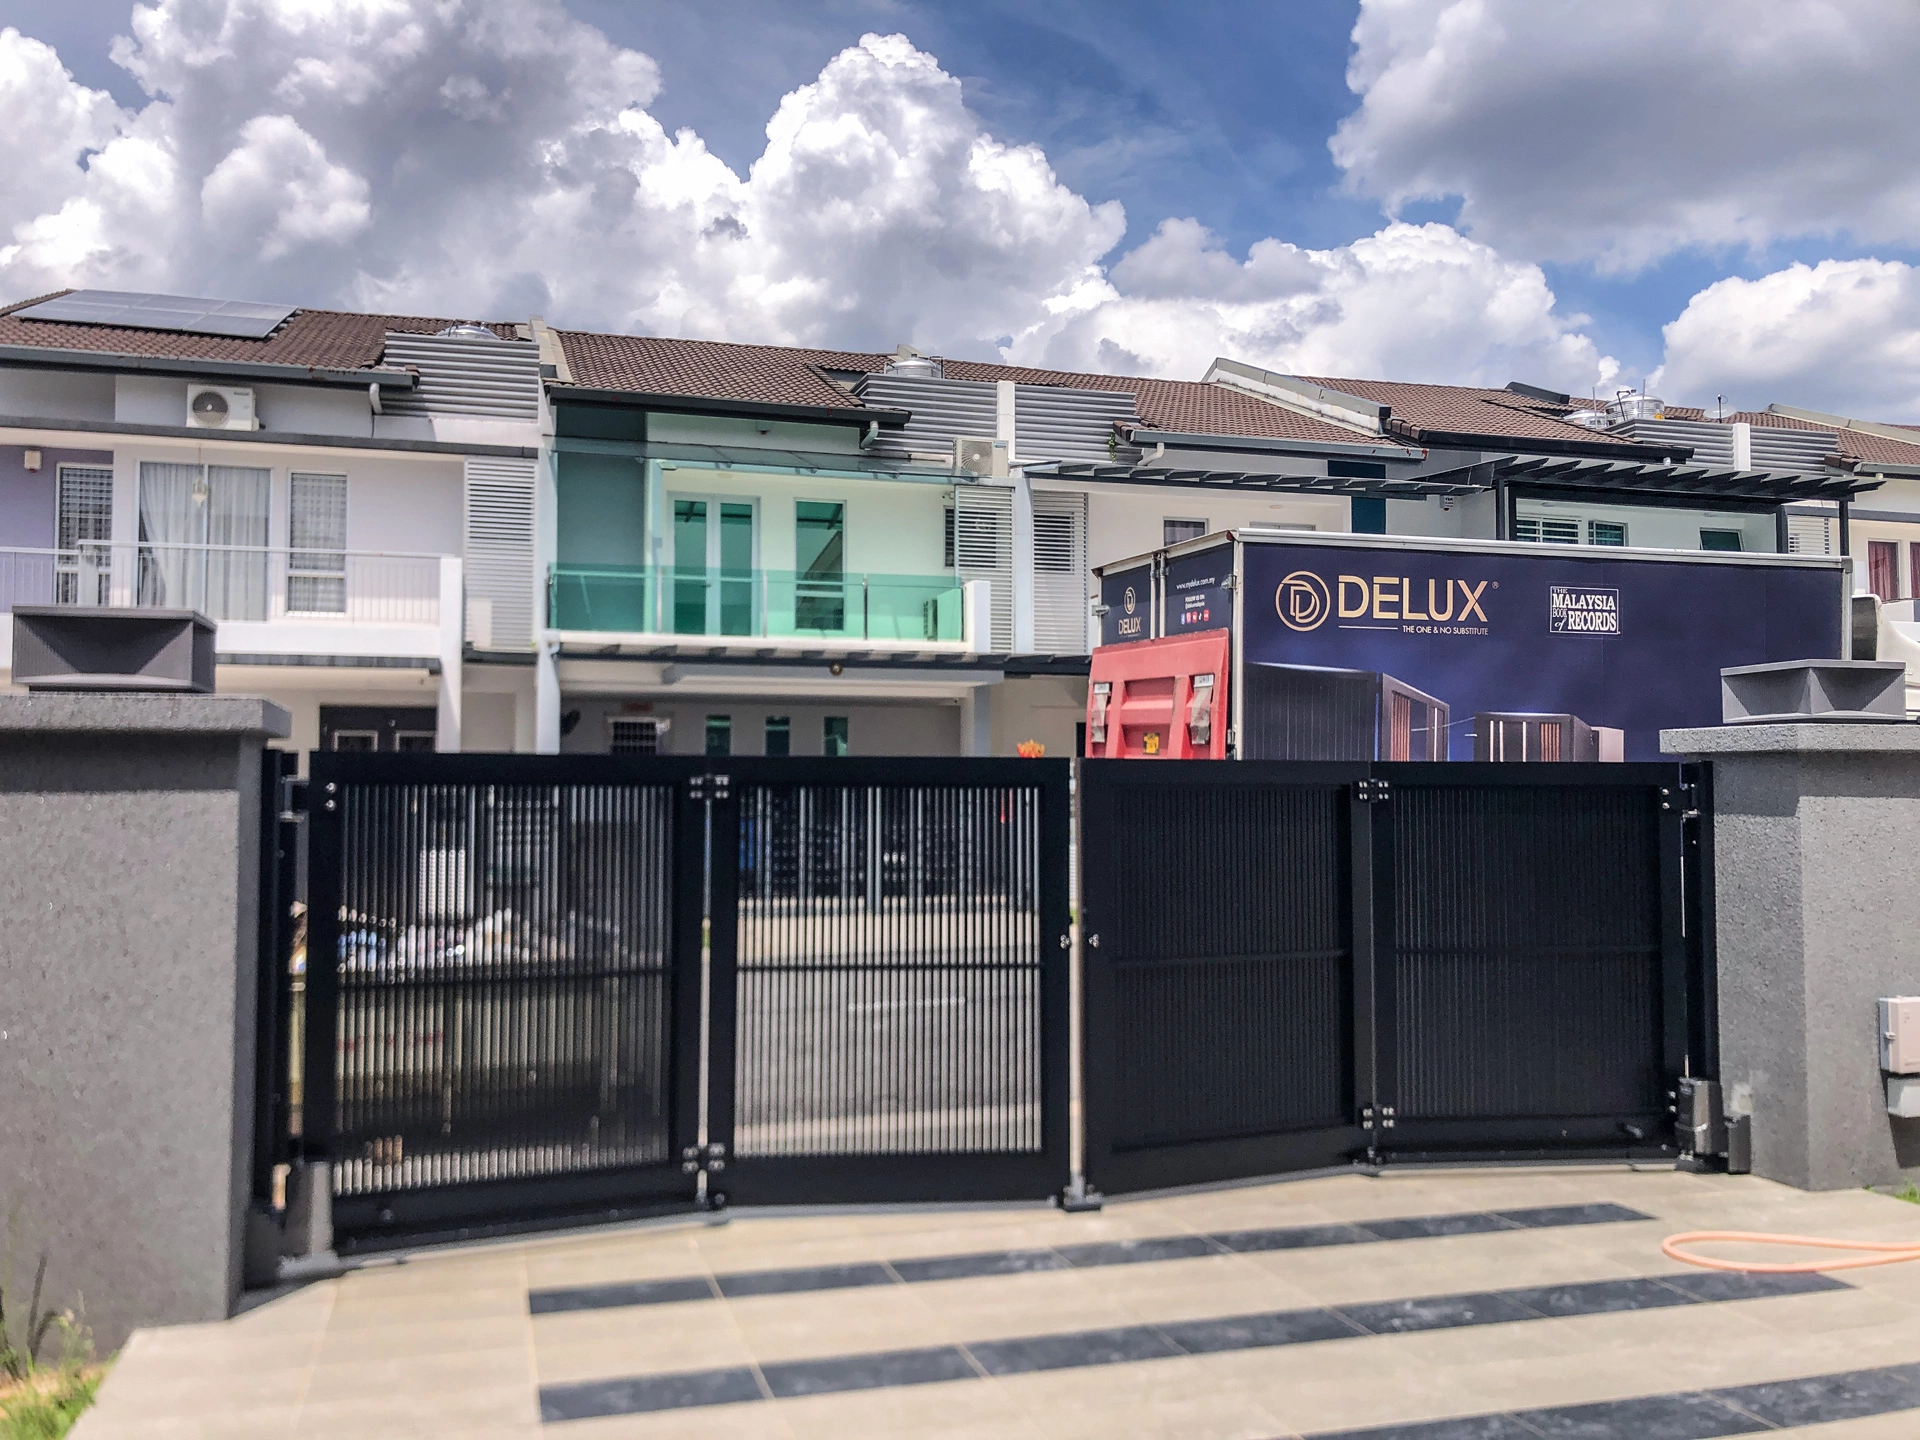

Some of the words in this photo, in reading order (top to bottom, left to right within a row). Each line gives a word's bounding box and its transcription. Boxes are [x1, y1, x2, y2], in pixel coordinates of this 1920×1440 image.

[1338, 575, 1488, 622] DELUX
[1552, 593, 1616, 610] MALAYSIA
[1552, 608, 1568, 617] BOOK
[1554, 617, 1568, 631] of
[1567, 610, 1617, 631] RECORDS
[1118, 617, 1142, 635] DELUX
[1402, 625, 1415, 633] THE
[1416, 625, 1432, 634] ONE
[1433, 626, 1438, 634] &
[1439, 626, 1452, 634] NO
[1453, 626, 1489, 636] SUBSTITUTE
